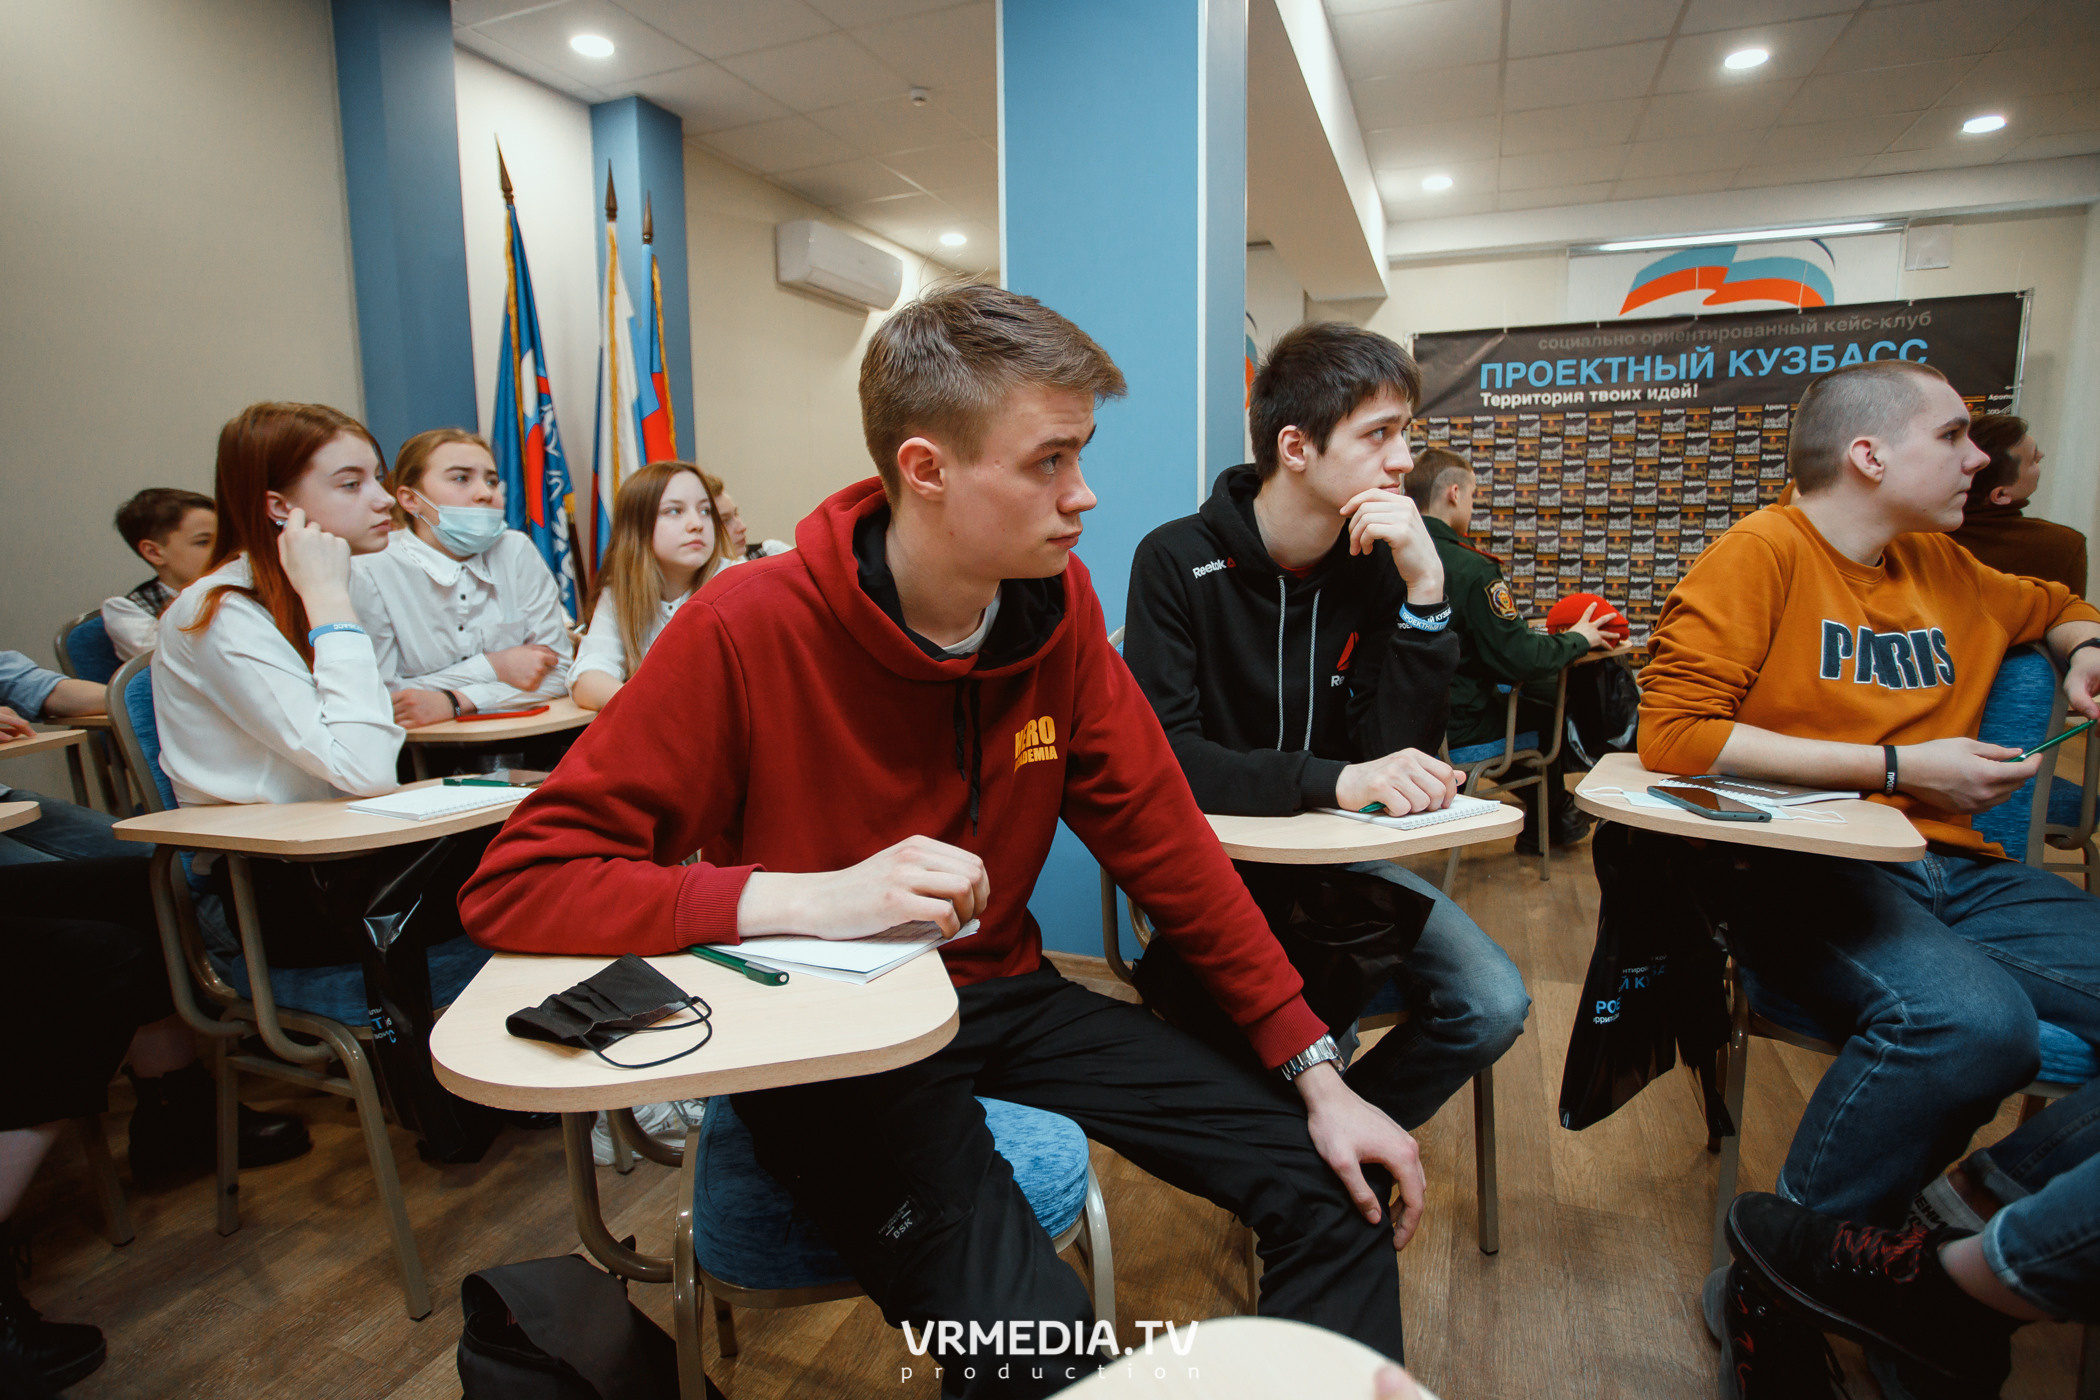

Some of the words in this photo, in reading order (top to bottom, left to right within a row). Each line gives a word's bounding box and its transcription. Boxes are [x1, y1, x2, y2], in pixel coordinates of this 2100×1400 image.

[1538, 333, 1636, 351] социально
[1641, 318, 1818, 348] ориентированный
[1823, 311, 1933, 334] кейс-клуб
[1480, 345, 1715, 390] ПРОЕКТНЫЙ
[1728, 338, 1929, 378] КУЗБАСС
[1480, 391, 1584, 409] Территория
[1589, 389, 1641, 402] твоих
[1647, 383, 1698, 402] идей!
[1819, 619, 1956, 690] PARIS
